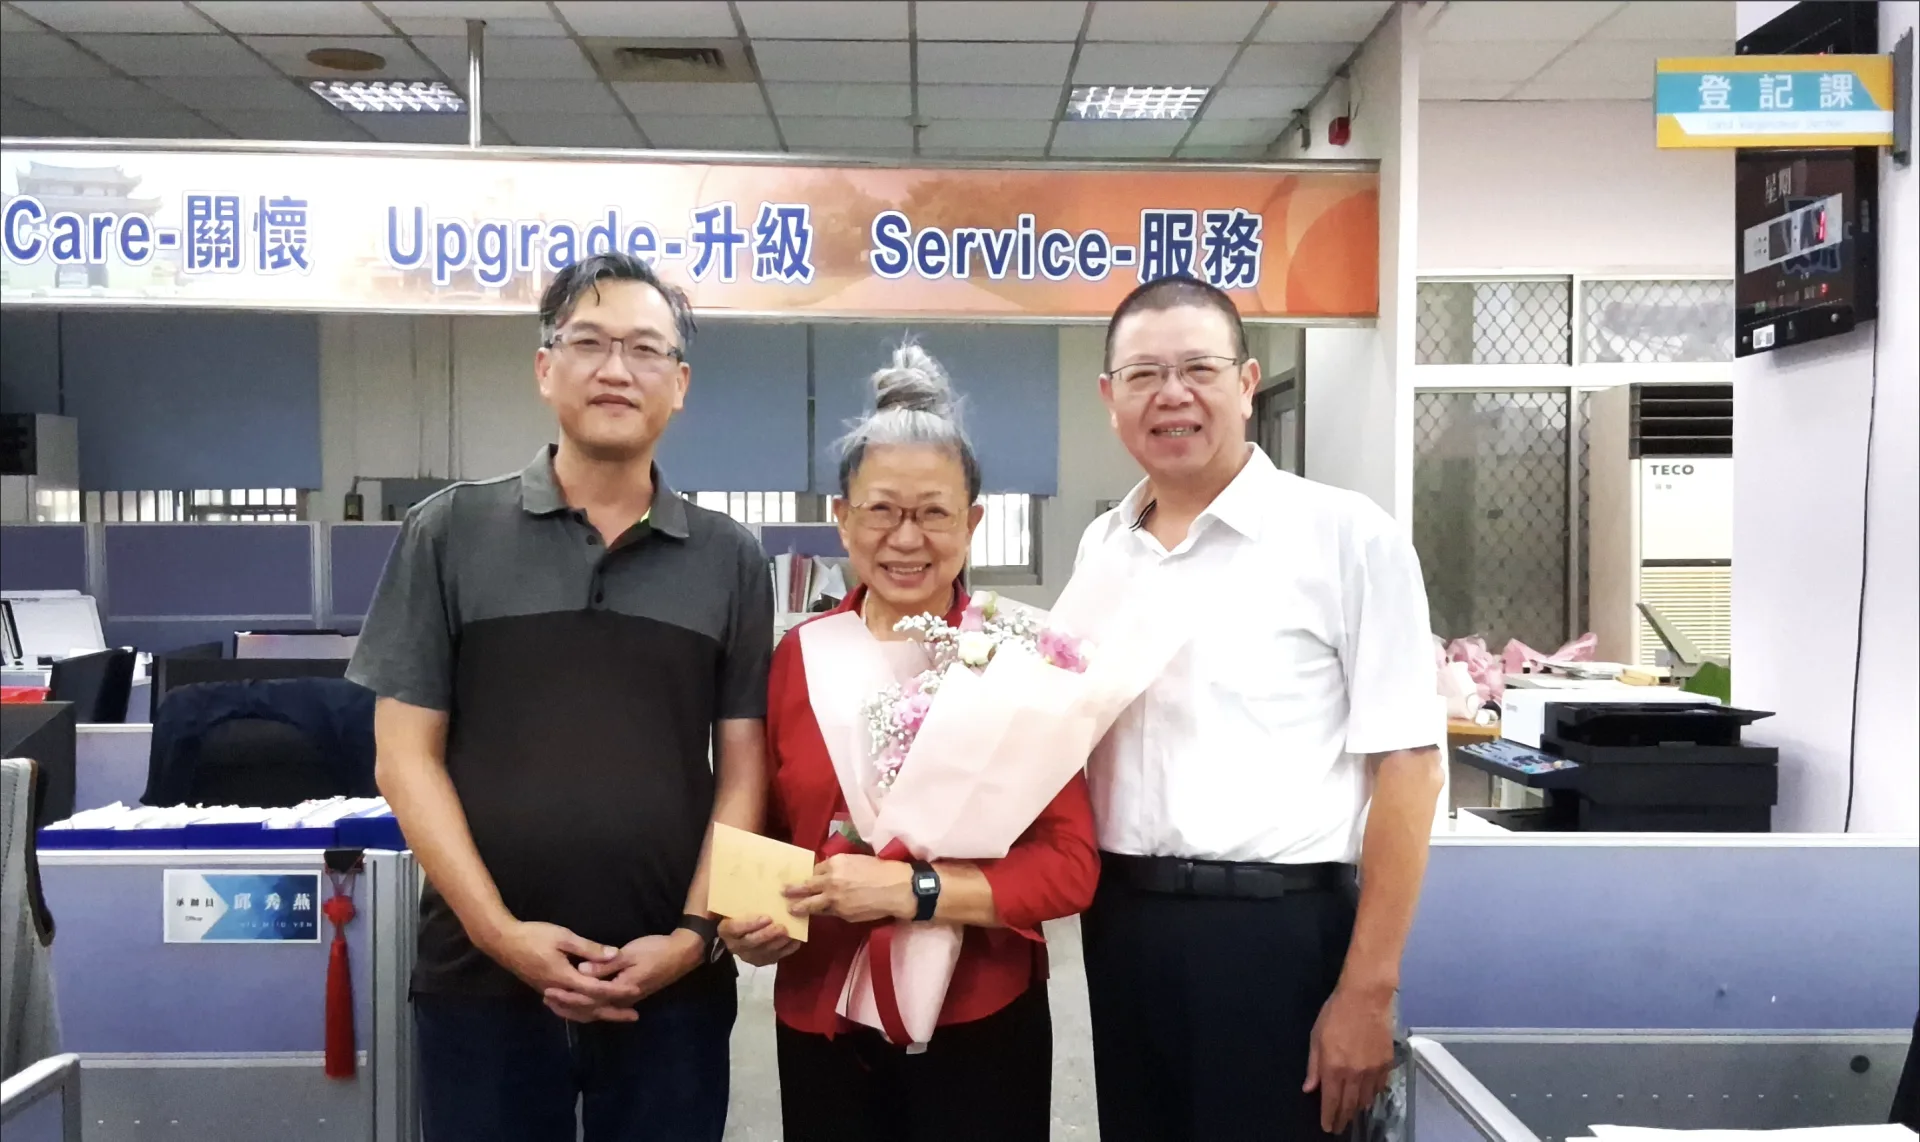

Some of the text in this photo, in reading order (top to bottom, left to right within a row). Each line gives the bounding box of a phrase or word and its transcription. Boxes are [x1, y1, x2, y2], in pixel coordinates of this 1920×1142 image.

[1698, 73, 1853, 110] 登記課
[3, 195, 1260, 285] Care-關懷 Upgrade-升級 Service-服務
[1650, 464, 1694, 475] TECO
